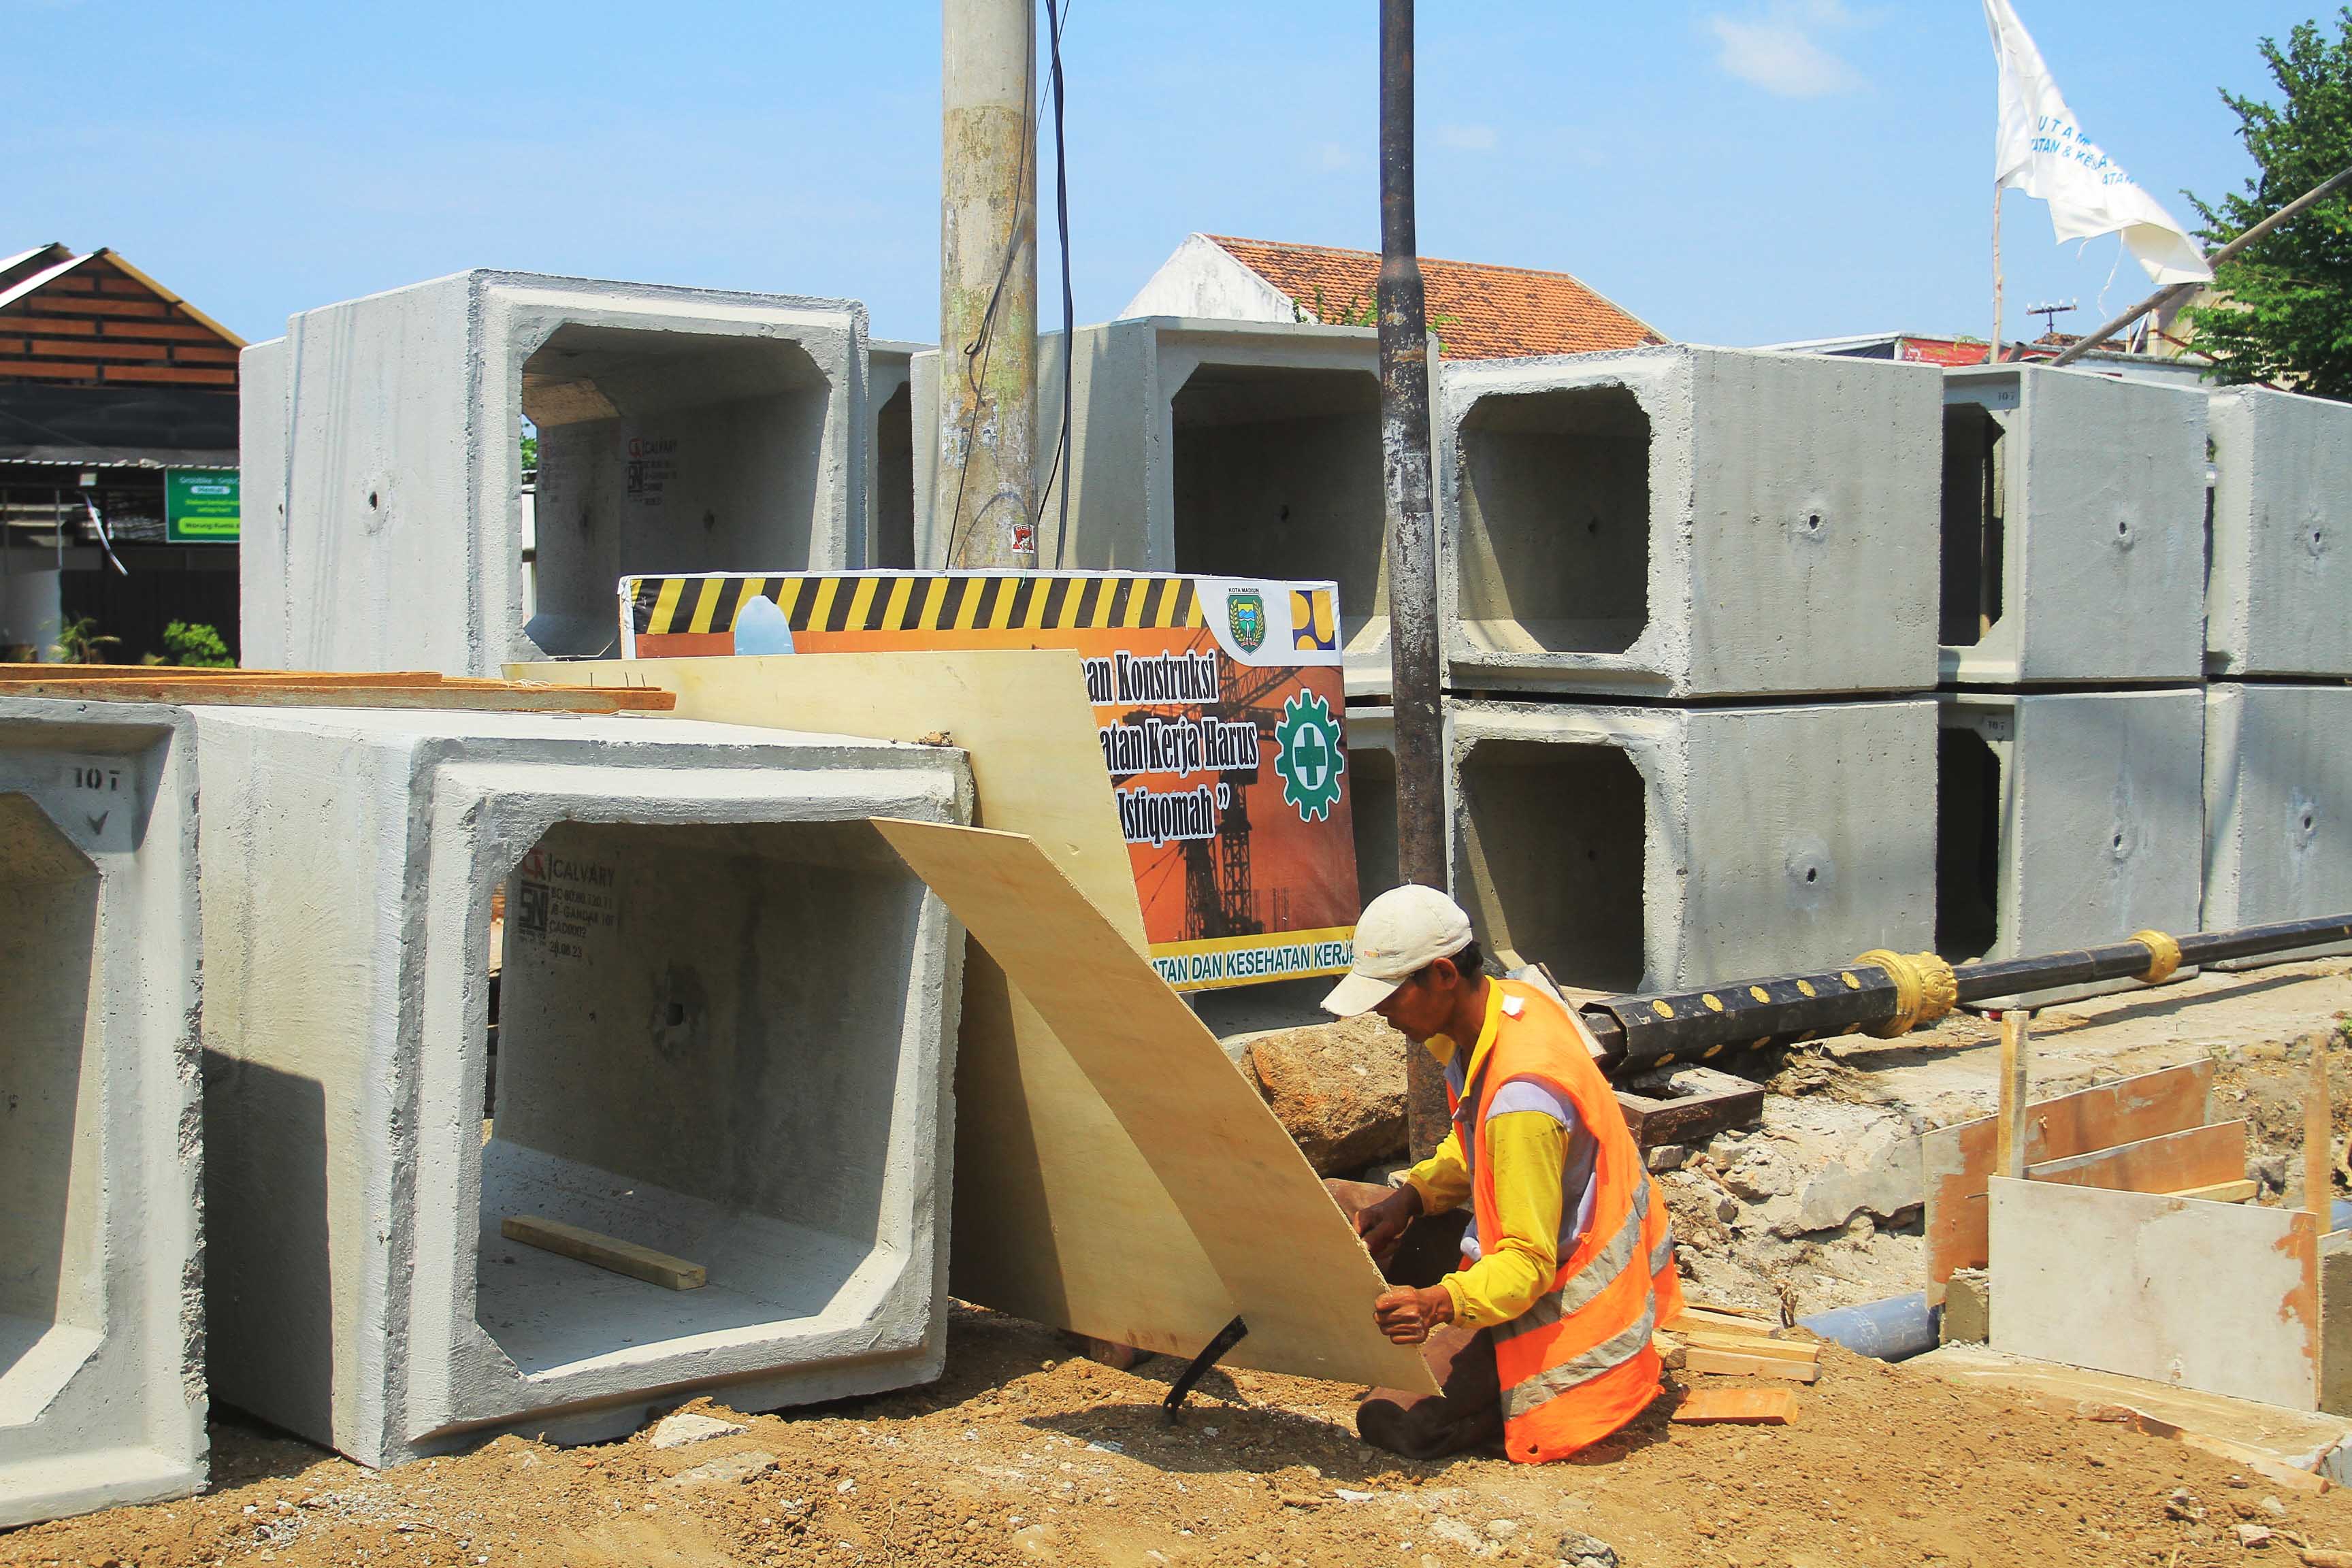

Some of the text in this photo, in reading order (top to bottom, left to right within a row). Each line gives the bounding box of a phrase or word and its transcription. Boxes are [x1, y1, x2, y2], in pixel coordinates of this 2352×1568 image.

[2063, 145, 2071, 158] &
[1081, 651, 1217, 702] an Konstruksi
[1147, 720, 1200, 774] Kerja
[1203, 720, 1258, 767] Harus
[553, 860, 616, 888] CALVARY
[1192, 954, 1222, 979] DAN
[1226, 945, 1310, 977] KESEHATAN
